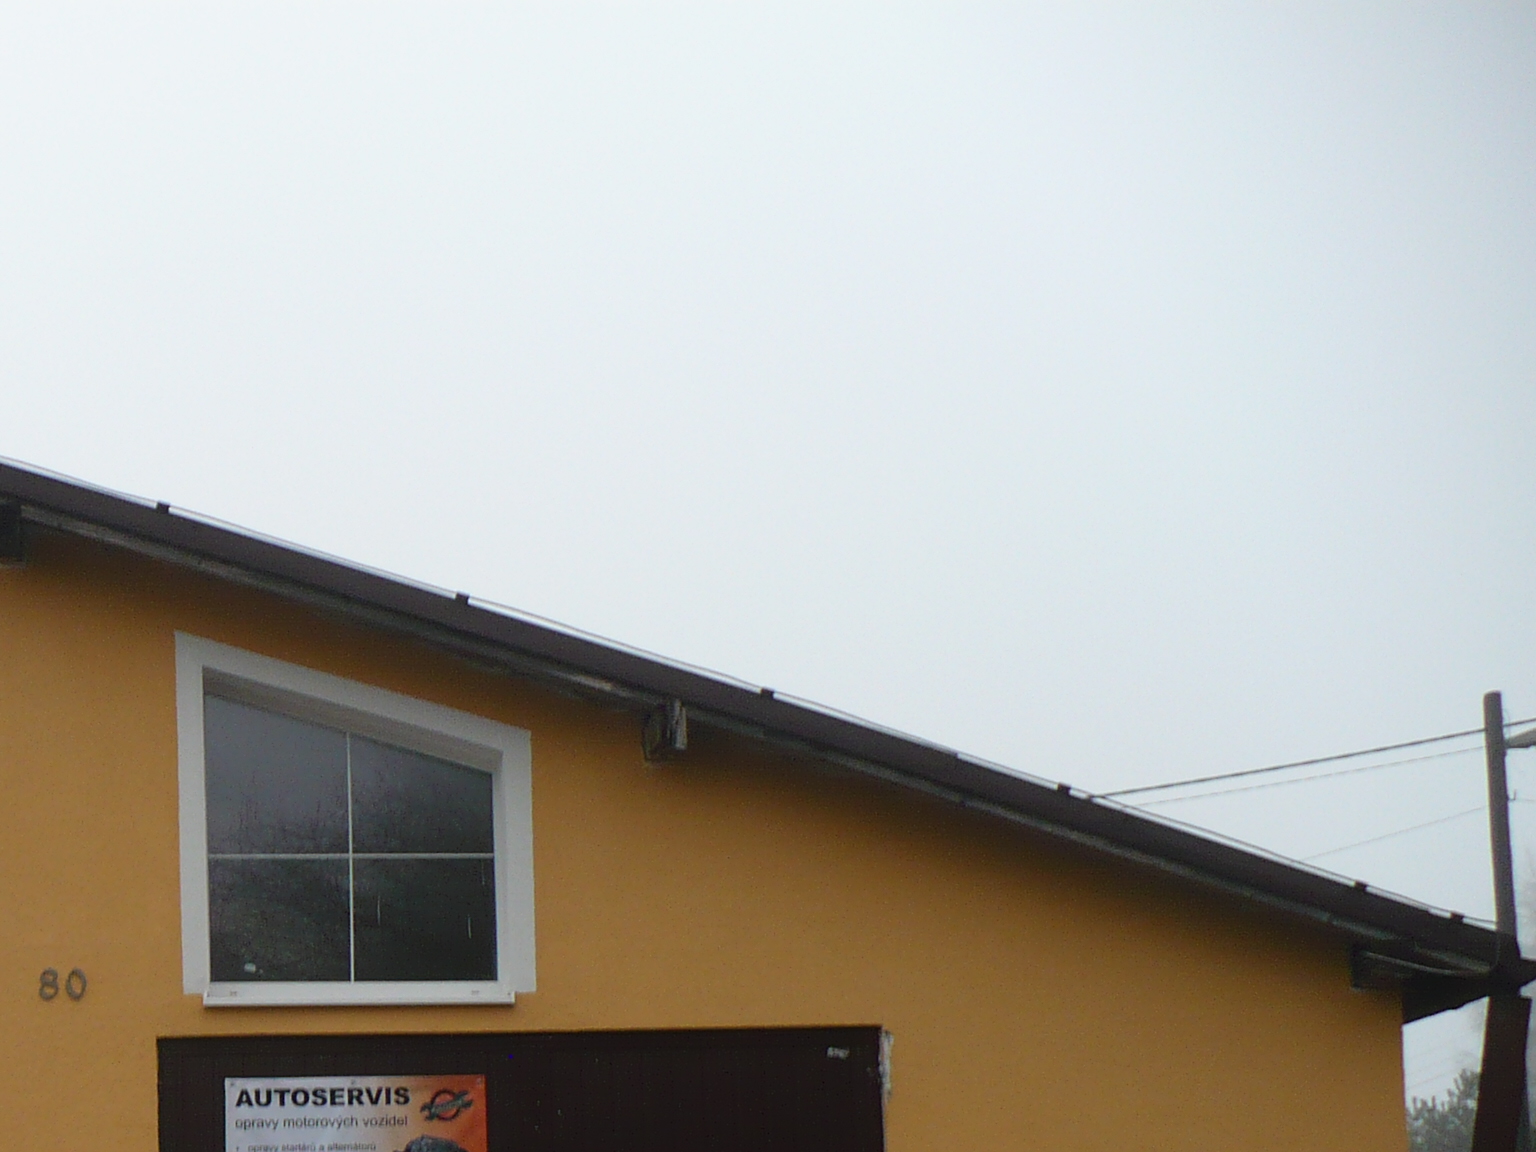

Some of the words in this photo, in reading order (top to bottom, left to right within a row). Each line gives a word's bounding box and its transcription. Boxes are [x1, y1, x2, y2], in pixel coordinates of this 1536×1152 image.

[39, 967, 87, 1001] 80
[235, 1087, 410, 1107] AUTOSERVIS
[235, 1119, 279, 1131] opravy
[283, 1115, 358, 1130] motorových
[363, 1114, 408, 1127] vozidel
